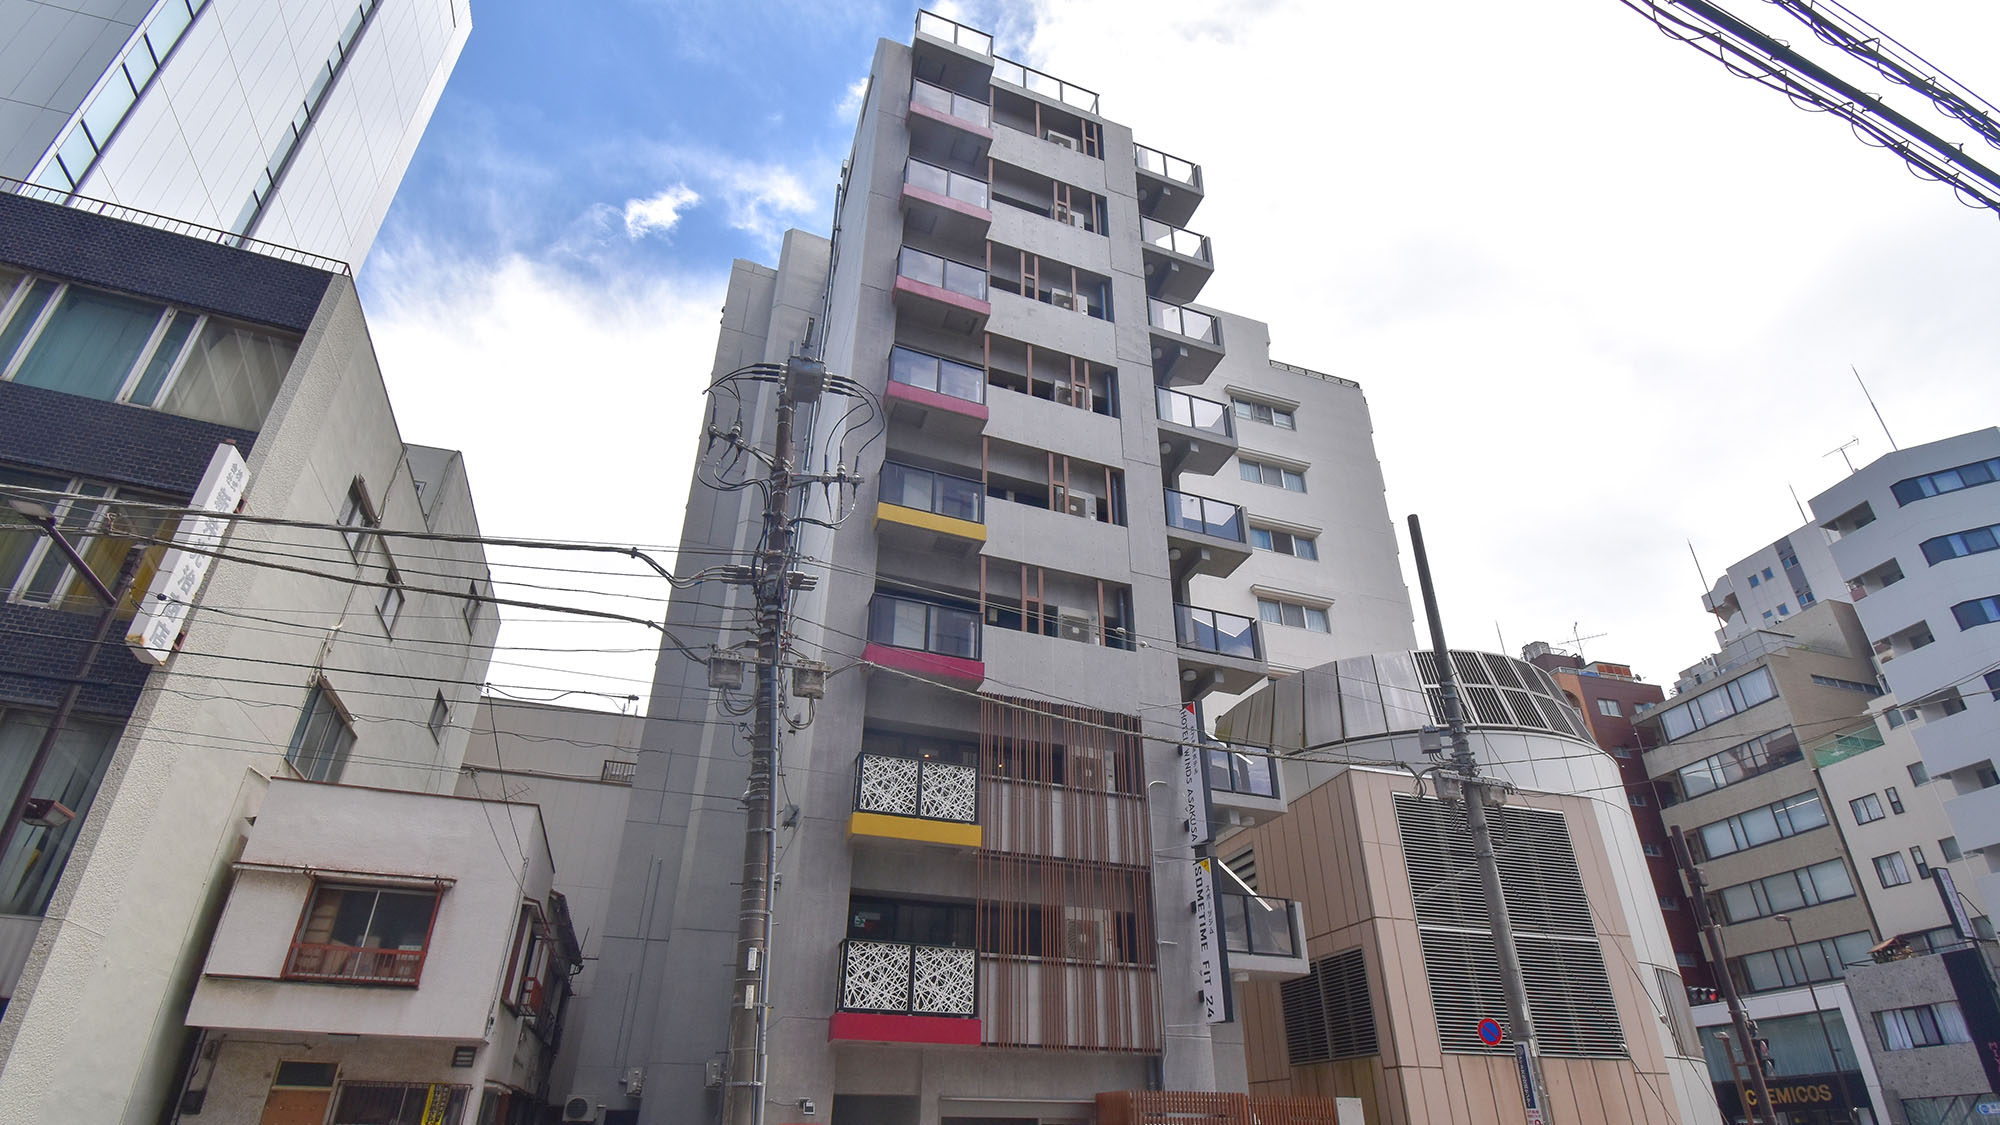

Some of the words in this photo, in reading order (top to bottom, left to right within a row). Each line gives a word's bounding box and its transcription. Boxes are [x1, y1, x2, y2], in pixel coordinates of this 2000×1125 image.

[1180, 710, 1189, 742] HOTEL
[1183, 749, 1193, 785] WINDS
[1187, 788, 1198, 842] ASAKUSA
[1194, 866, 1209, 952] SOMETIME
[1202, 960, 1213, 986] FIT
[1205, 995, 1215, 1018] 24
[1745, 1084, 1832, 1106] CEMICOS
